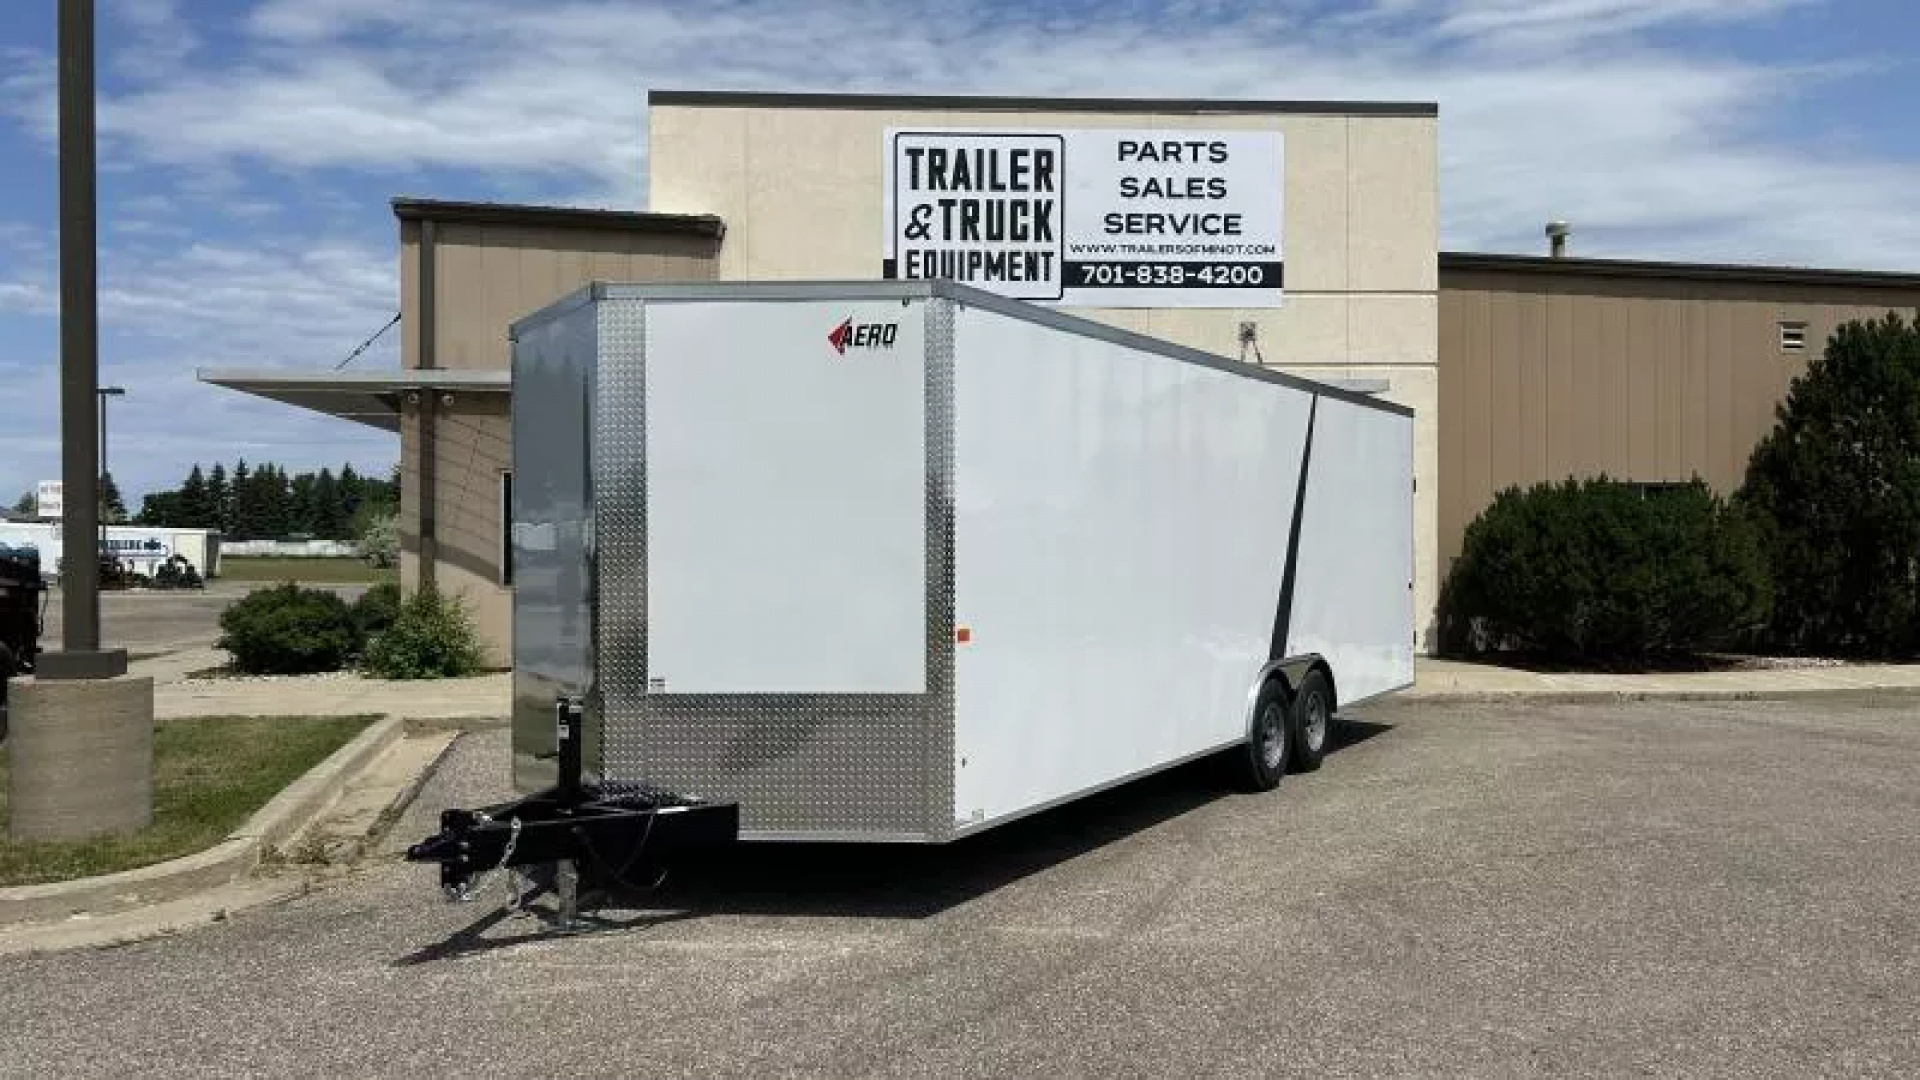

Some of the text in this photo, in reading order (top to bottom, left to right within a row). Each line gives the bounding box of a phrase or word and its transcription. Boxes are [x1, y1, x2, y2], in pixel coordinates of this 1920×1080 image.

[1117, 141, 1229, 163] PARTS
[905, 148, 1054, 192] TRAILER
[1119, 177, 1228, 199] SALES
[905, 198, 1054, 242] & TRUCK
[1103, 213, 1243, 235] SERVICE
[1070, 244, 1276, 255] WWW.TRAILERSOFMINOT.COM
[906, 249, 1055, 281] EQUIPMENT
[1081, 265, 1264, 284] 701-838-4200
[840, 323, 898, 348] AERO
